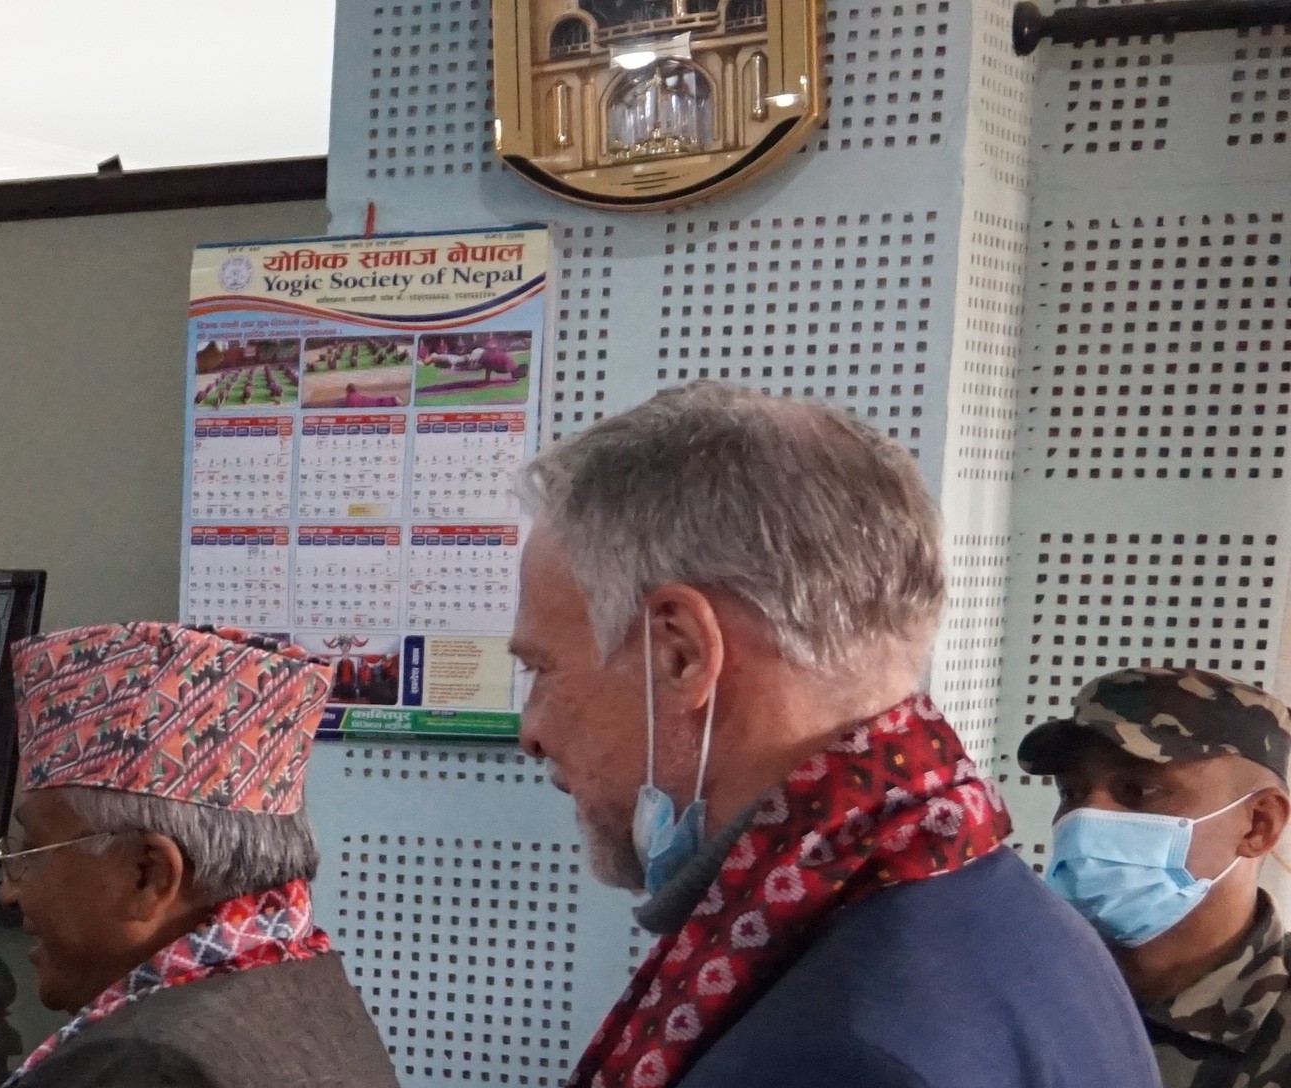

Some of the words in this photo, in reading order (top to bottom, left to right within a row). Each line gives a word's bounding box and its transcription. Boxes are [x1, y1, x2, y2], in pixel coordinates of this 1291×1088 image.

[263, 249, 350, 271] योगिक
[358, 248, 439, 269] समाज
[446, 241, 526, 264] नेपाल
[263, 273, 323, 297] Yogic
[330, 271, 414, 292] Society
[421, 267, 447, 286] of
[453, 264, 523, 289] Nepal
